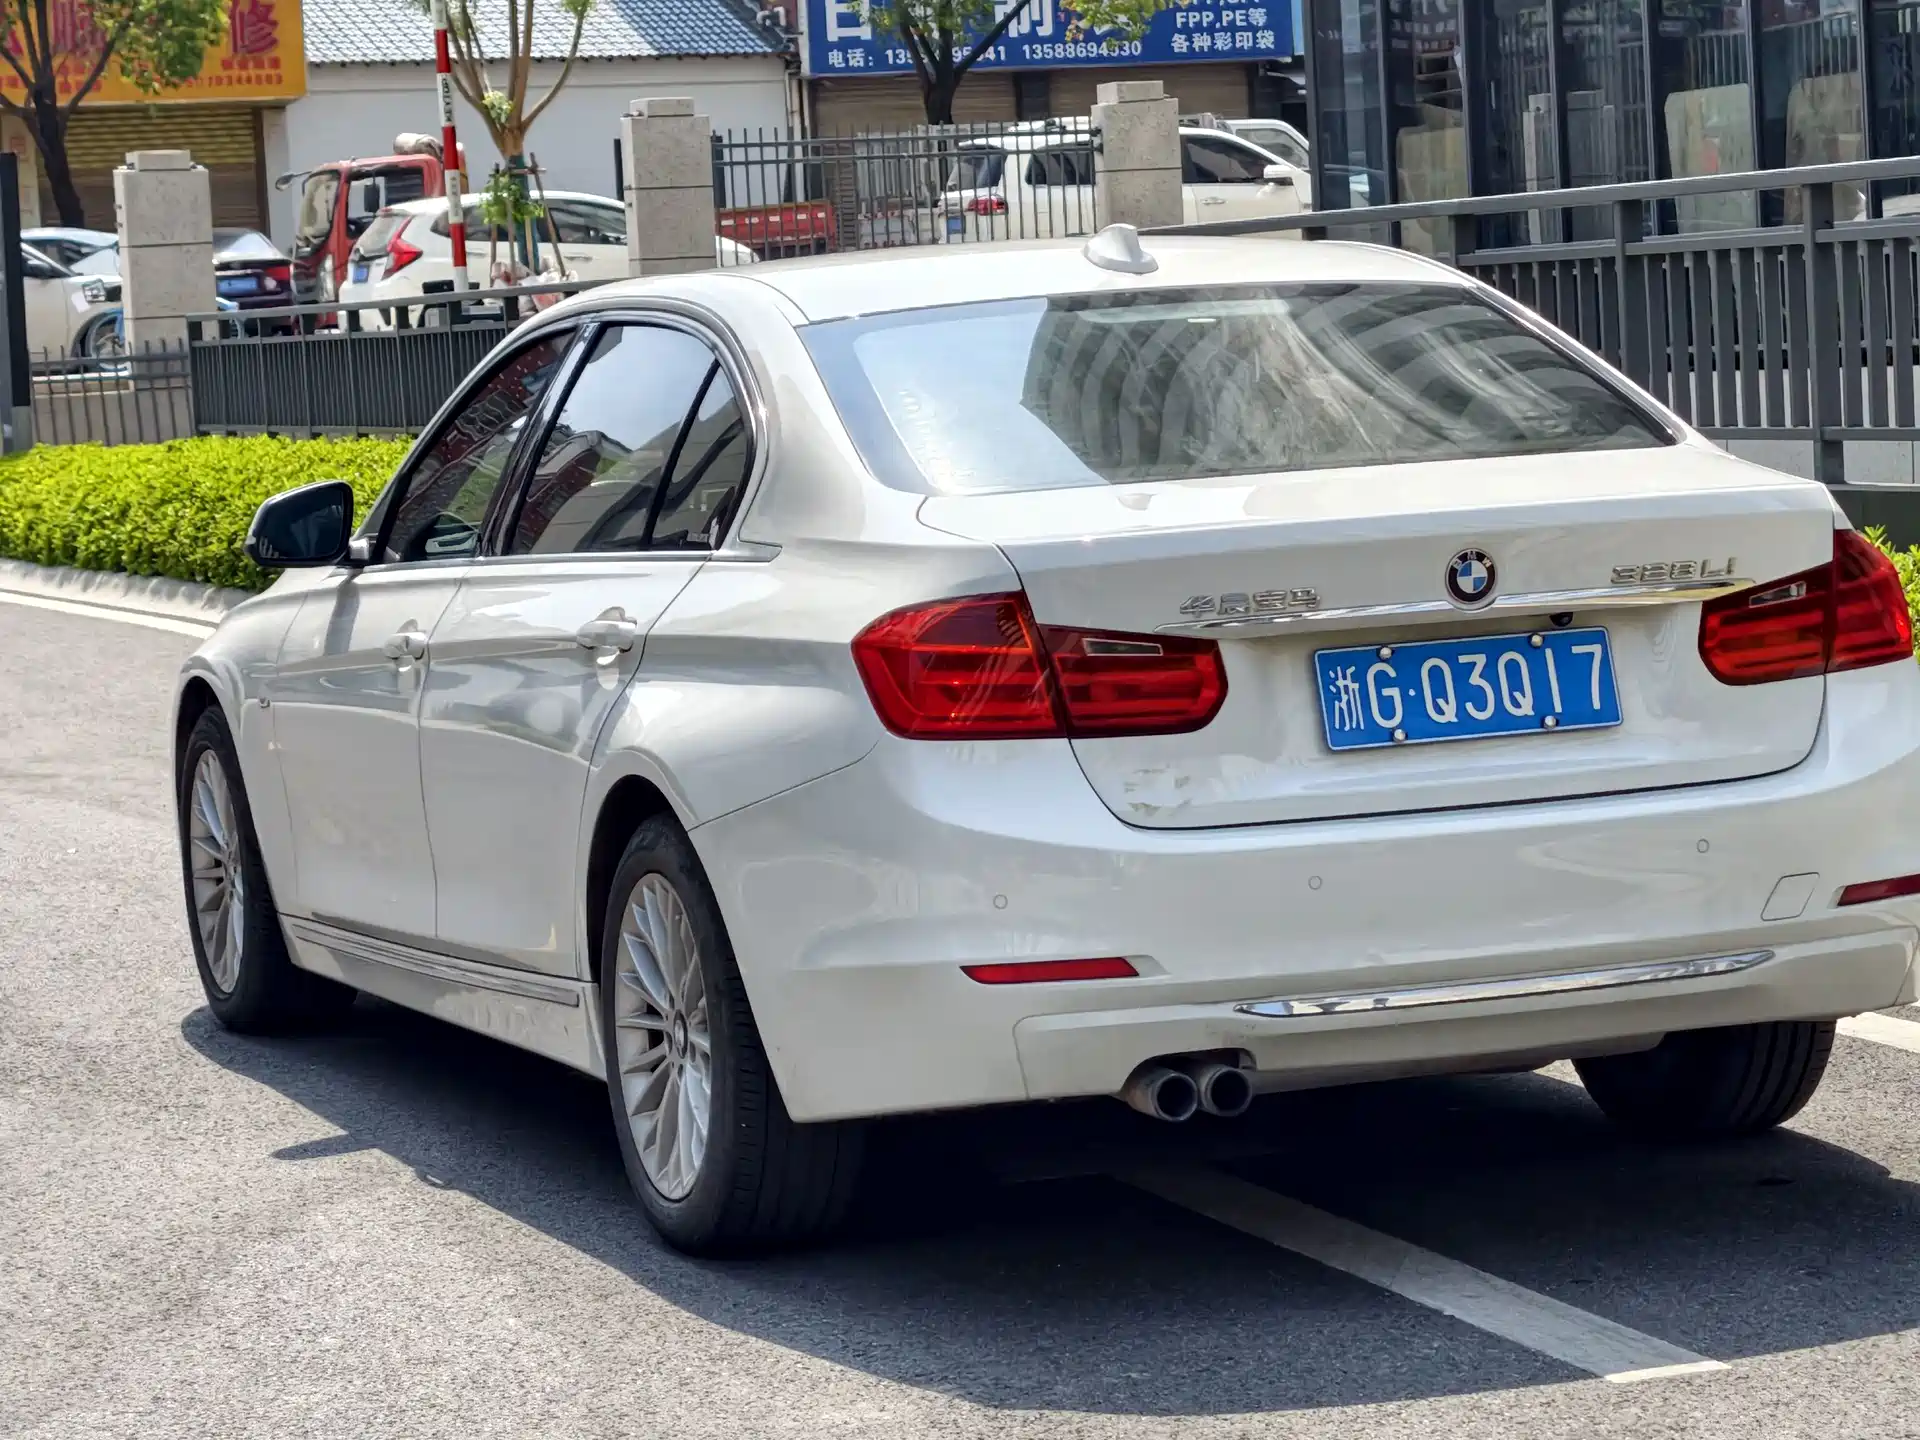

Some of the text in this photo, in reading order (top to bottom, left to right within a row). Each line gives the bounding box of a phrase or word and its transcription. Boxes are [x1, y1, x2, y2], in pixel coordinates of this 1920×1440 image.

[1171, 30, 1275, 53] 各种彩印袋
